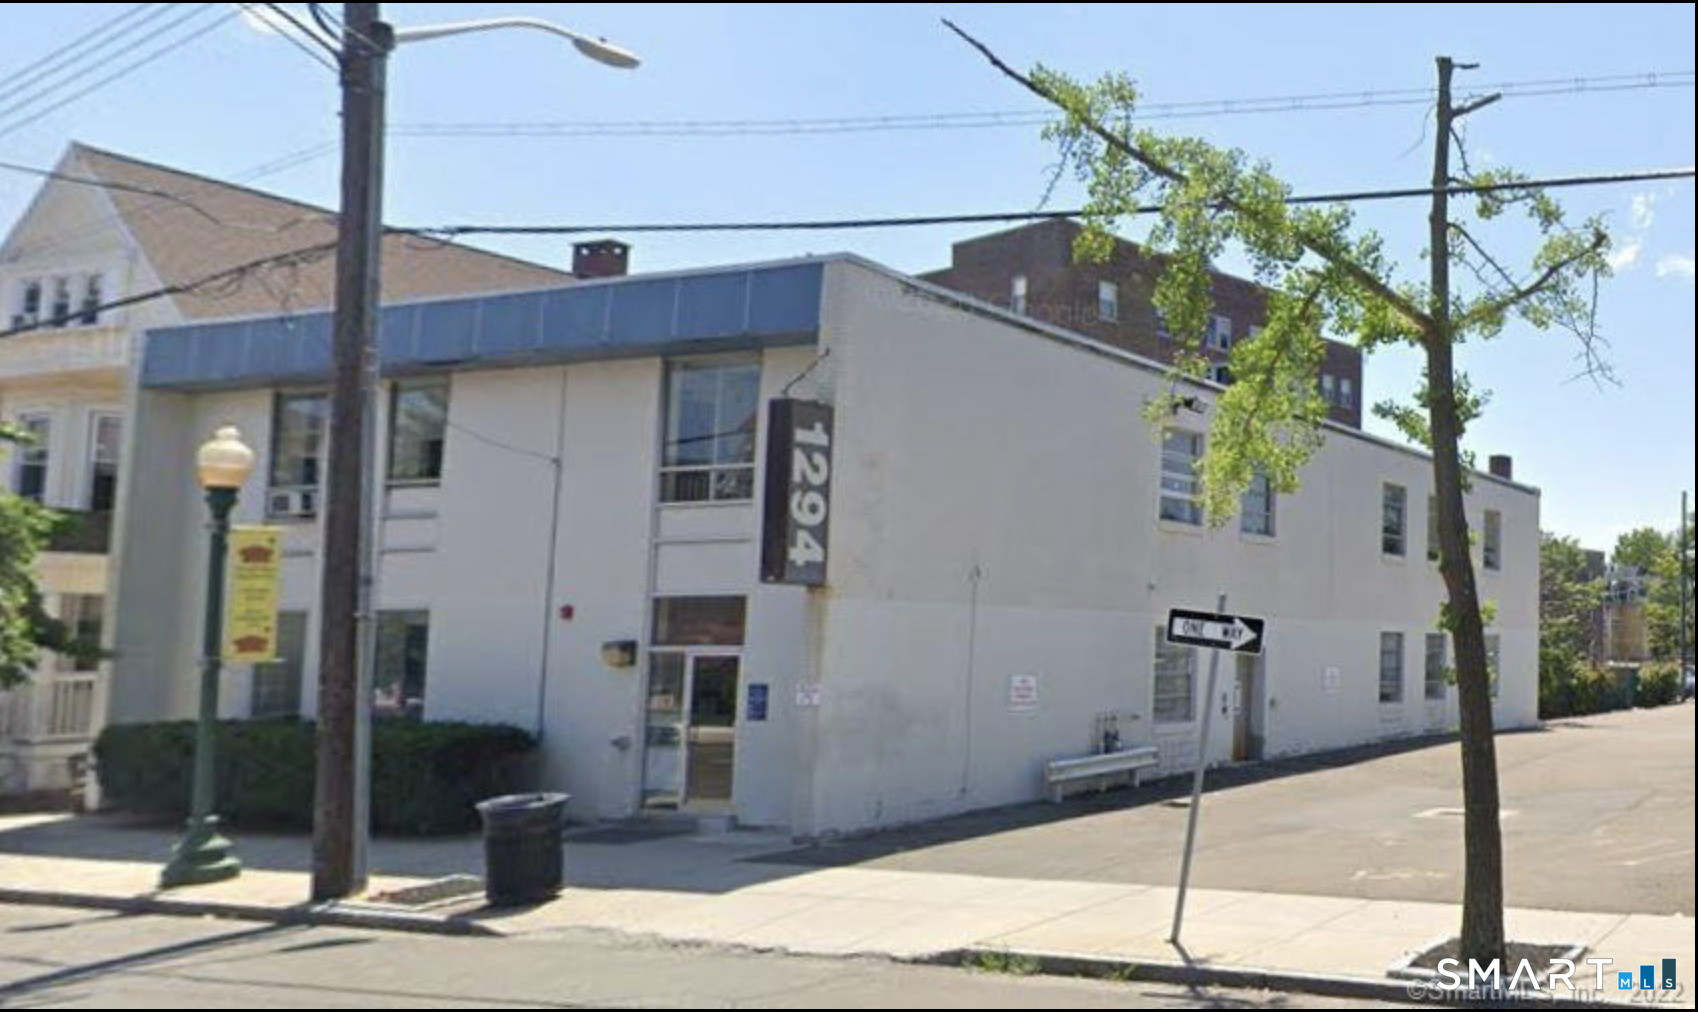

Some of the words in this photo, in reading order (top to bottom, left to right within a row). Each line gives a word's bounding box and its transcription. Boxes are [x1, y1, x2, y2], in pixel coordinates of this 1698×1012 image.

[788, 421, 829, 566] 1294
[1182, 619, 1206, 637] ONE
[1221, 625, 1244, 640] WAY
